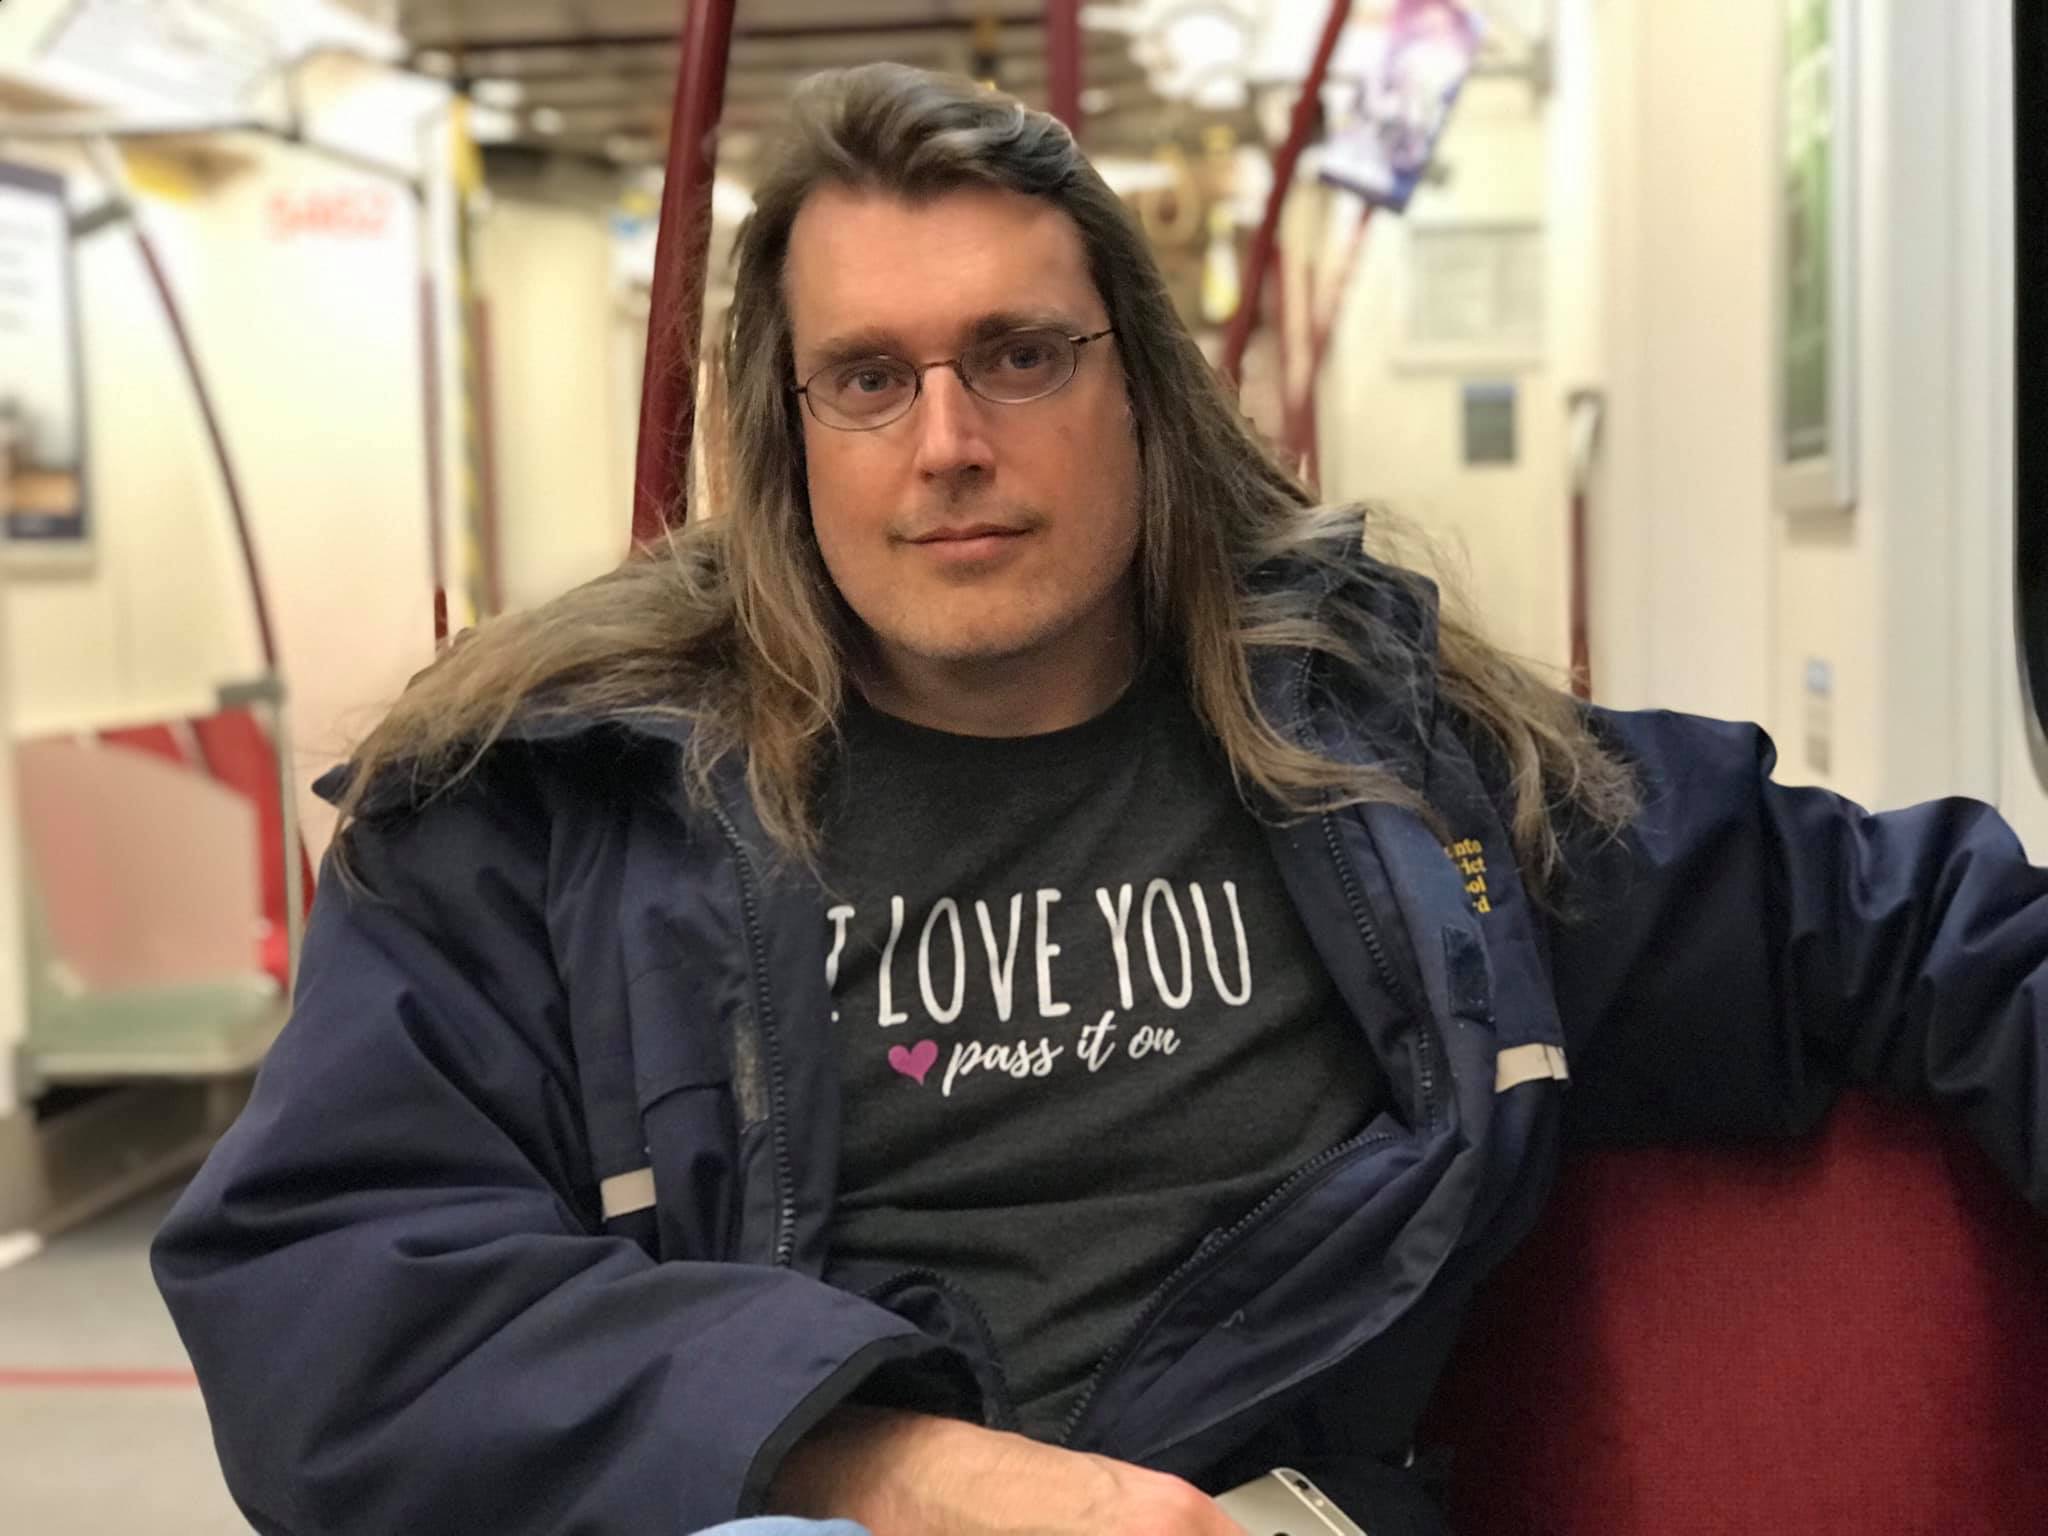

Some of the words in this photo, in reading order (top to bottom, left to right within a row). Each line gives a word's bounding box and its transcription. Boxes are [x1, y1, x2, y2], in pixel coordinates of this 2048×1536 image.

[1445, 838, 1482, 858] nto
[1459, 857, 1487, 875] ict
[878, 888, 1071, 1027] LOVE
[1095, 878, 1252, 1010] YOU
[941, 1036, 1064, 1097] pass
[1076, 1009, 1118, 1073] it
[1127, 1024, 1181, 1056] on
